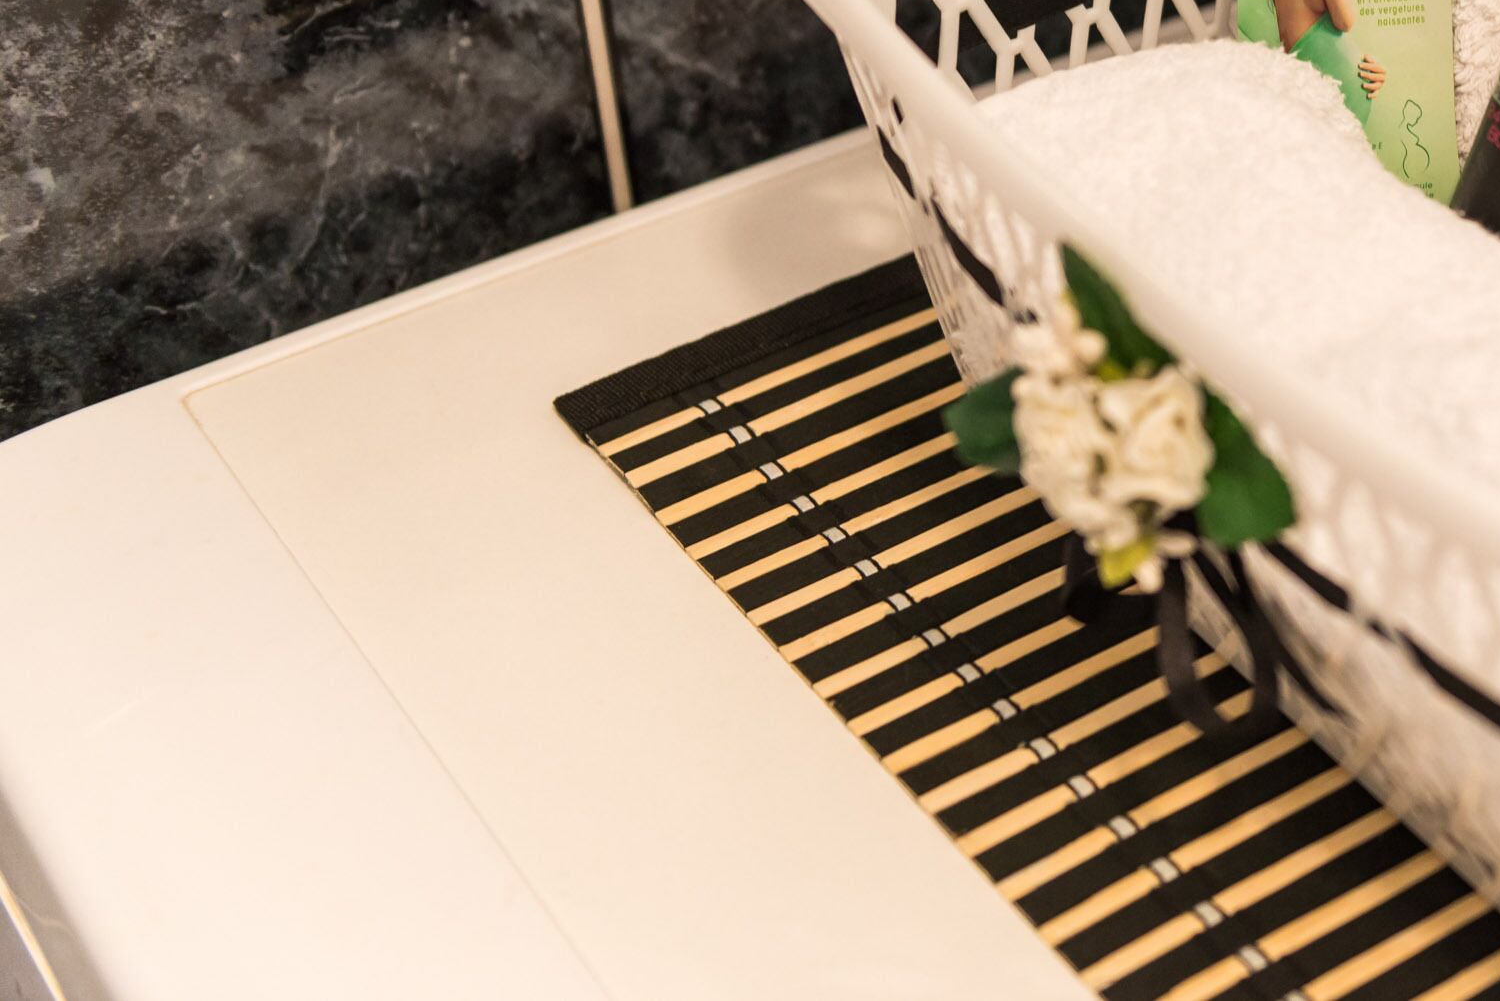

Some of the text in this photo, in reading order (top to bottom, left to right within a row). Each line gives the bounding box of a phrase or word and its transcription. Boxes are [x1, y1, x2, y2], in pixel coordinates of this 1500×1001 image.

[1359, 4, 1425, 16] des vergetures
[1377, 16, 1425, 26] naissantes
